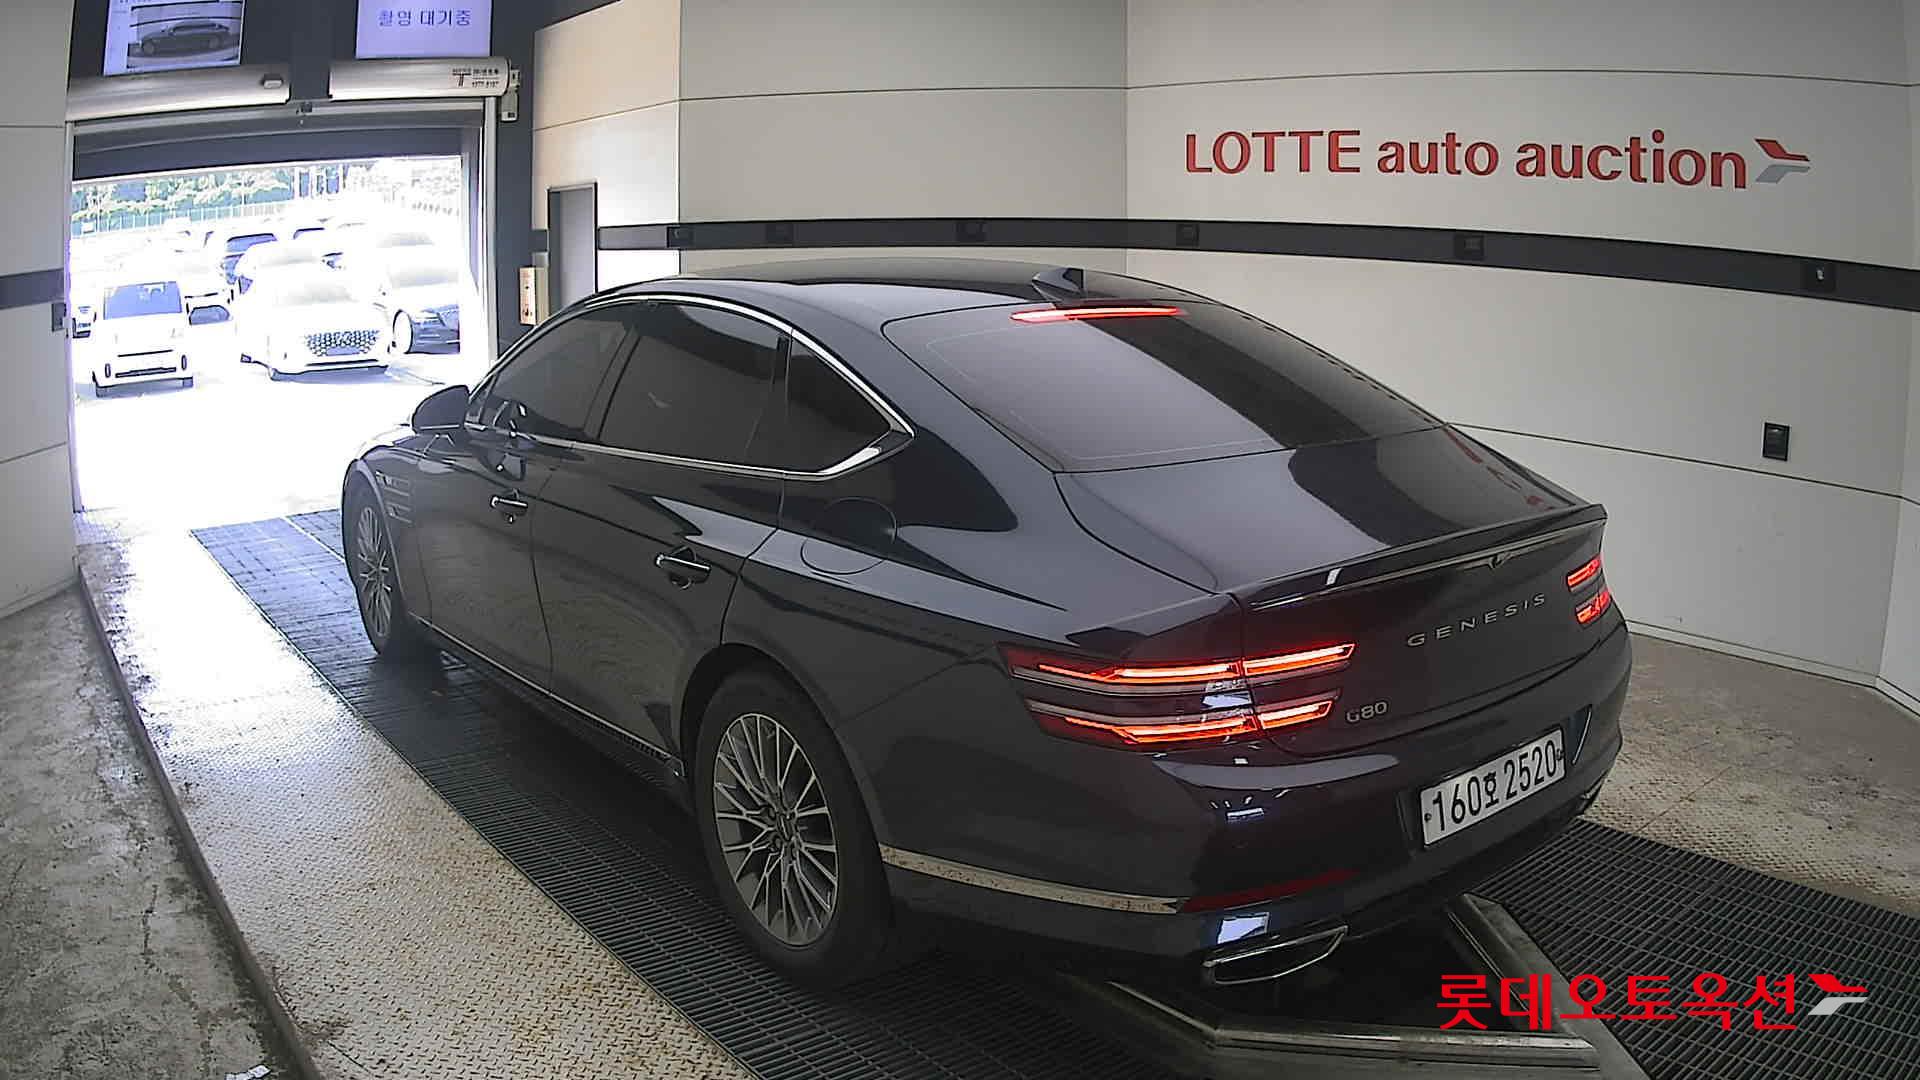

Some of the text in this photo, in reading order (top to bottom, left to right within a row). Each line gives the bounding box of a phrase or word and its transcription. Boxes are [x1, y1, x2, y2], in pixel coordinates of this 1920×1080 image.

[420, 9, 471, 26] 대기중
[1185, 130, 1747, 189] LOTTE auto auction
[1407, 594, 1545, 646] GENESIS
[1346, 701, 1388, 723] G80
[1432, 739, 1557, 831] 160호 2520
